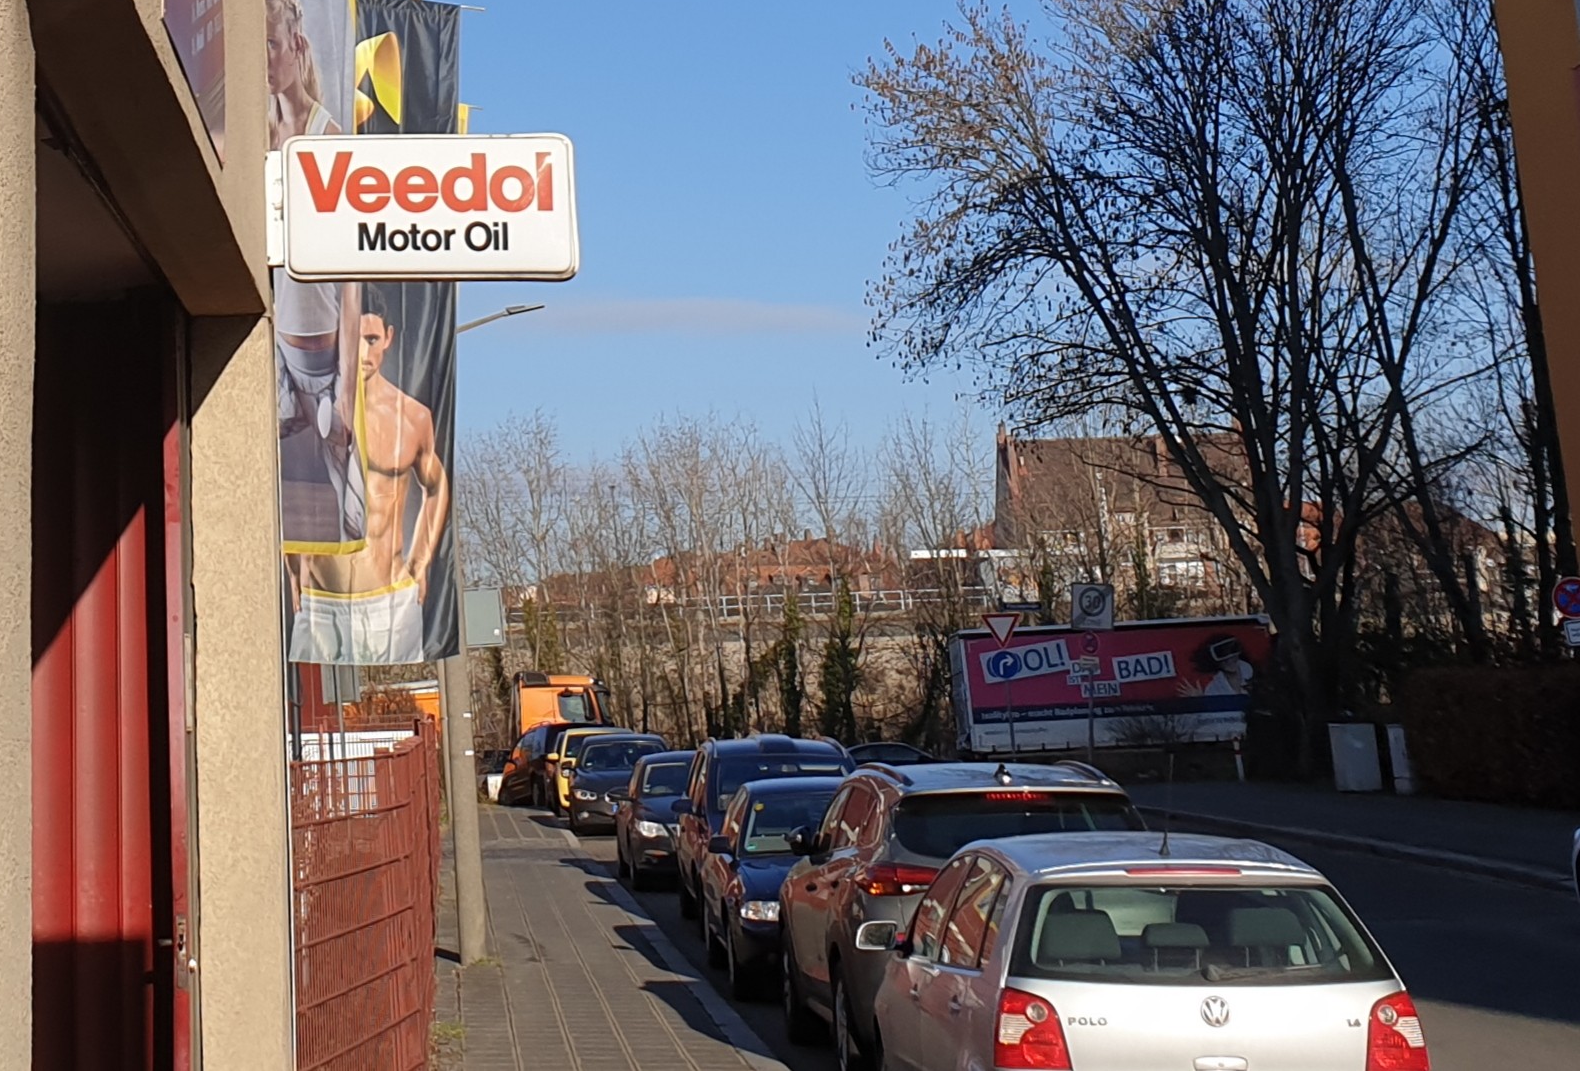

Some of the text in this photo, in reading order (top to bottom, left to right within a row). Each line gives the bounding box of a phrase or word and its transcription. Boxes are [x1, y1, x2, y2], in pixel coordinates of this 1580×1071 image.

[296, 151, 554, 213] Veedol
[357, 221, 509, 251] Motor Oil
[1084, 594, 1101, 610] 30
[986, 643, 1065, 678] OL!
[1117, 654, 1171, 678] BAD!
[1067, 1016, 1108, 1026] POLO
